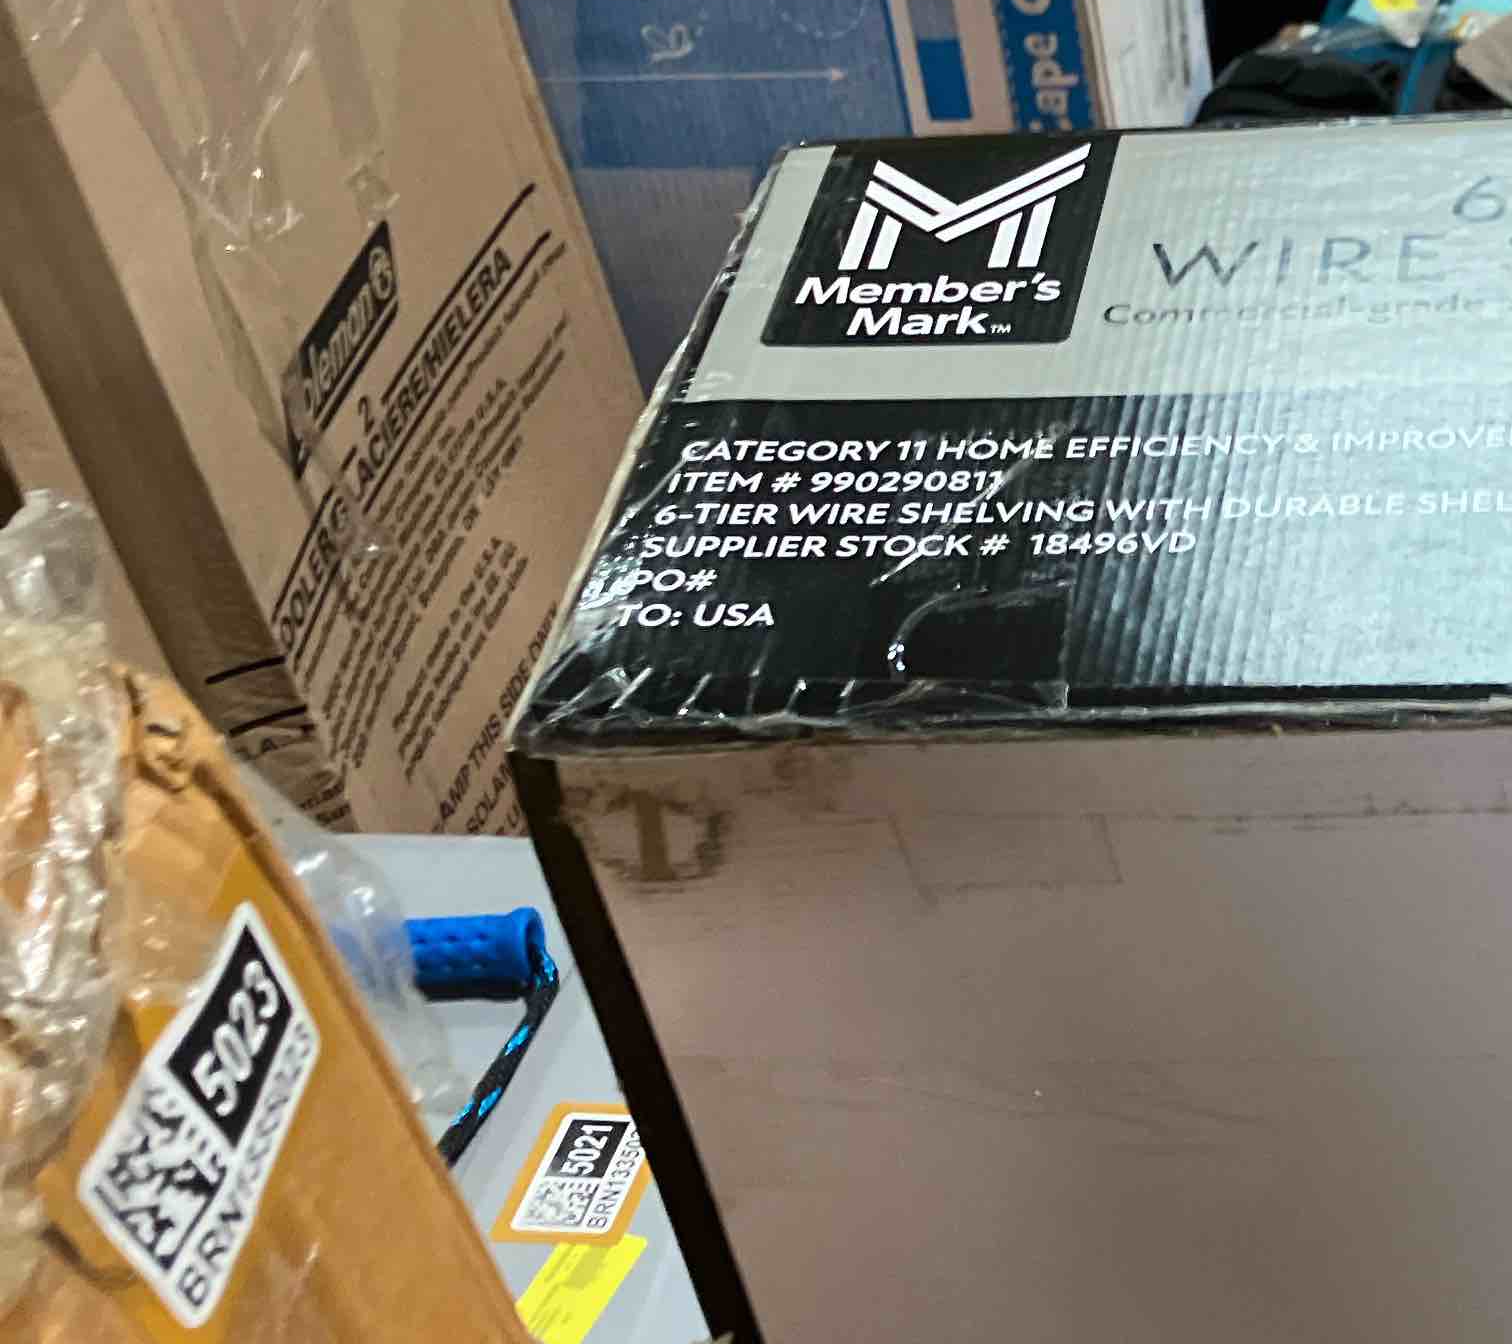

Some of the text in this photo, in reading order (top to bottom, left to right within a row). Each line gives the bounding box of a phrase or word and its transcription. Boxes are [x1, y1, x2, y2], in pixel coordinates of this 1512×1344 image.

[1152, 235, 1449, 289] WIRE
[794, 271, 1063, 305] Member's
[845, 305, 990, 337] Mark
[681, 439, 891, 463] CATEGORY
[898, 439, 928, 462] 11
[937, 436, 1056, 463] HOME
[1065, 432, 1289, 460] EFFICIENCY
[1293, 431, 1321, 455] &
[667, 469, 1004, 495] ITEM # 990290811
[652, 502, 778, 527] 6-TIER
[788, 502, 891, 526] WIRE
[896, 498, 1096, 526] SHELVING
[1105, 495, 1212, 523] WITH
[1220, 491, 1408, 521] DURABLE
[638, 530, 1198, 559] SUPPLIER STOCK # 18496VD
[628, 568, 719, 594] PO#
[615, 602, 776, 628] TO: USA
[192, 960, 279, 1117] 5023
[559, 1124, 614, 1176] 5021
